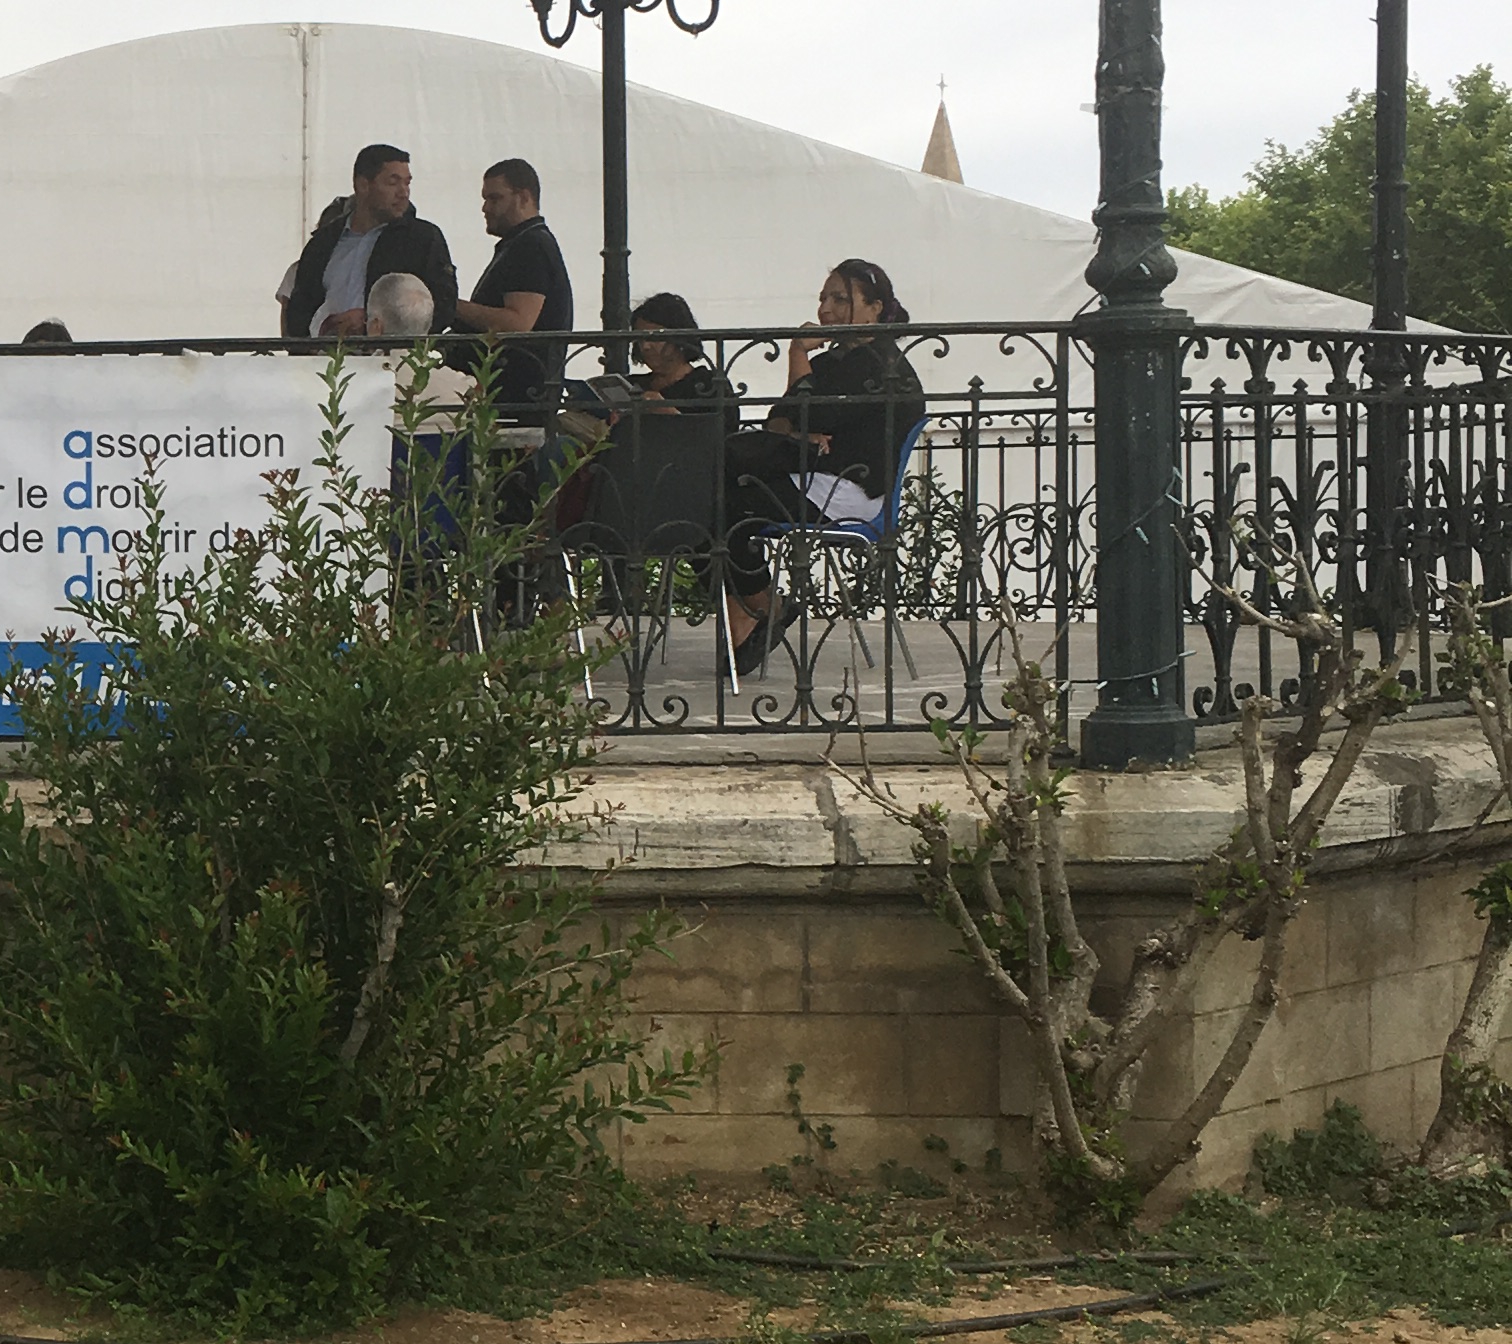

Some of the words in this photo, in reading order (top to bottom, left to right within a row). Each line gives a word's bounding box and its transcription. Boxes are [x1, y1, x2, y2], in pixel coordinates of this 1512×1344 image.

[63, 425, 285, 459] association
[18, 477, 48, 509] le
[63, 461, 154, 510] droi
[0, 521, 44, 553] de
[315, 520, 345, 553] la
